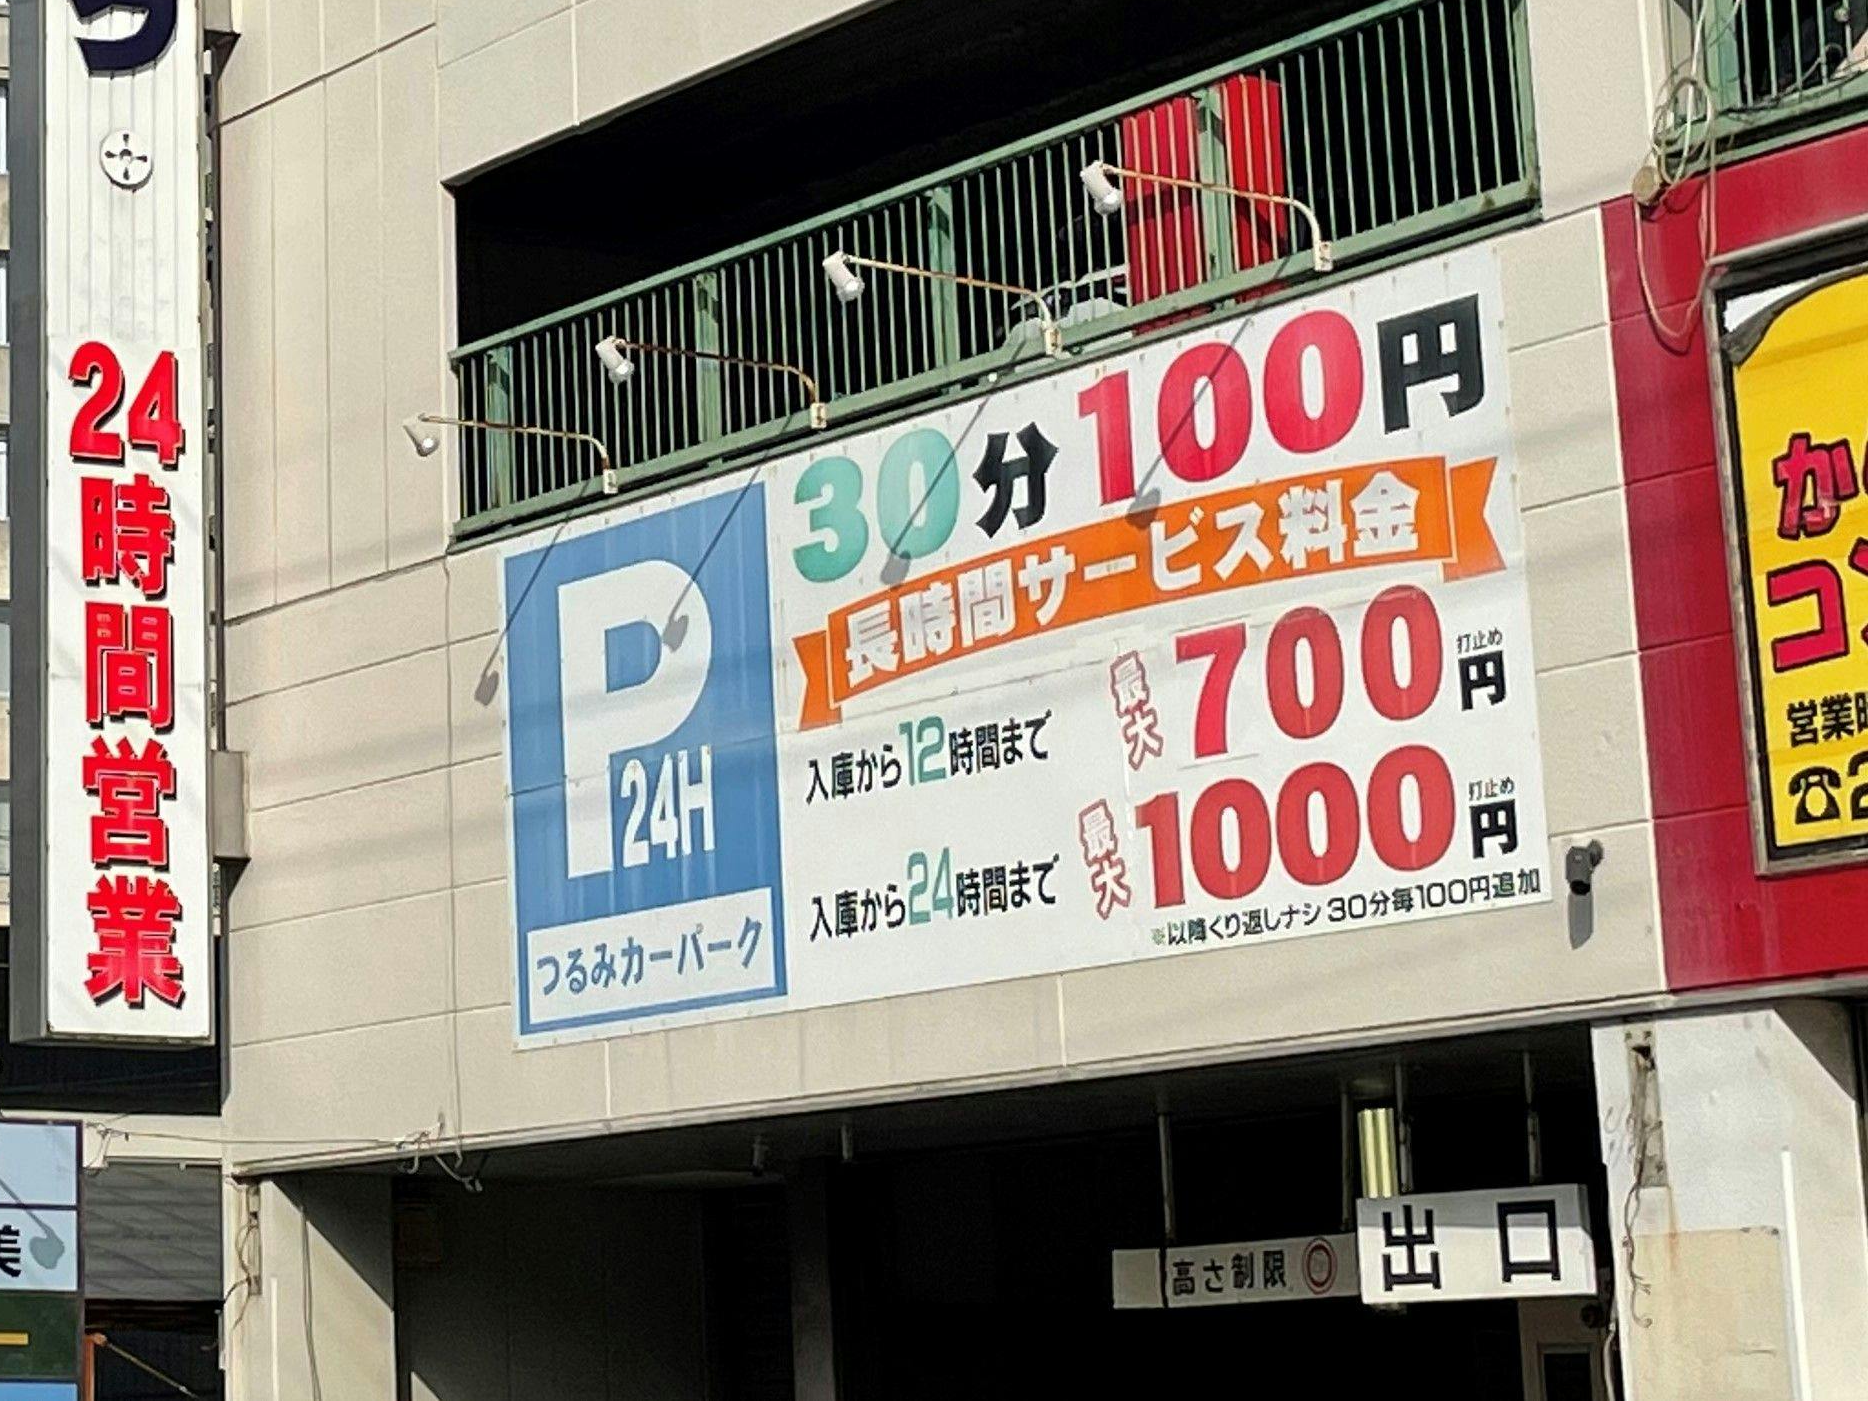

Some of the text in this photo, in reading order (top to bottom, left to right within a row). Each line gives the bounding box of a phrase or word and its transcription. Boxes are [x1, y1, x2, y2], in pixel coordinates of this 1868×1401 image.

[1772, 431, 1868, 541] か
[844, 471, 1421, 680] 長時間サービス料金
[1767, 537, 1868, 672] コ
[68, 340, 184, 1008] 24時間営業
[1456, 628, 1503, 653] 打止め
[558, 559, 712, 880] P
[806, 709, 1052, 805] 入庫から12時間まで
[1110, 650, 1163, 771] 最大
[1787, 692, 1868, 747] 営業
[621, 744, 715, 868] 24H
[1469, 776, 1515, 801] 打止め
[810, 846, 1059, 942] 入庫から24時間まで
[1078, 798, 1132, 920] 最大
[537, 916, 762, 996] つるみカーパーク
[1172, 1250, 1286, 1296] 高さ制限
[1381, 1200, 1562, 1292] 出口
